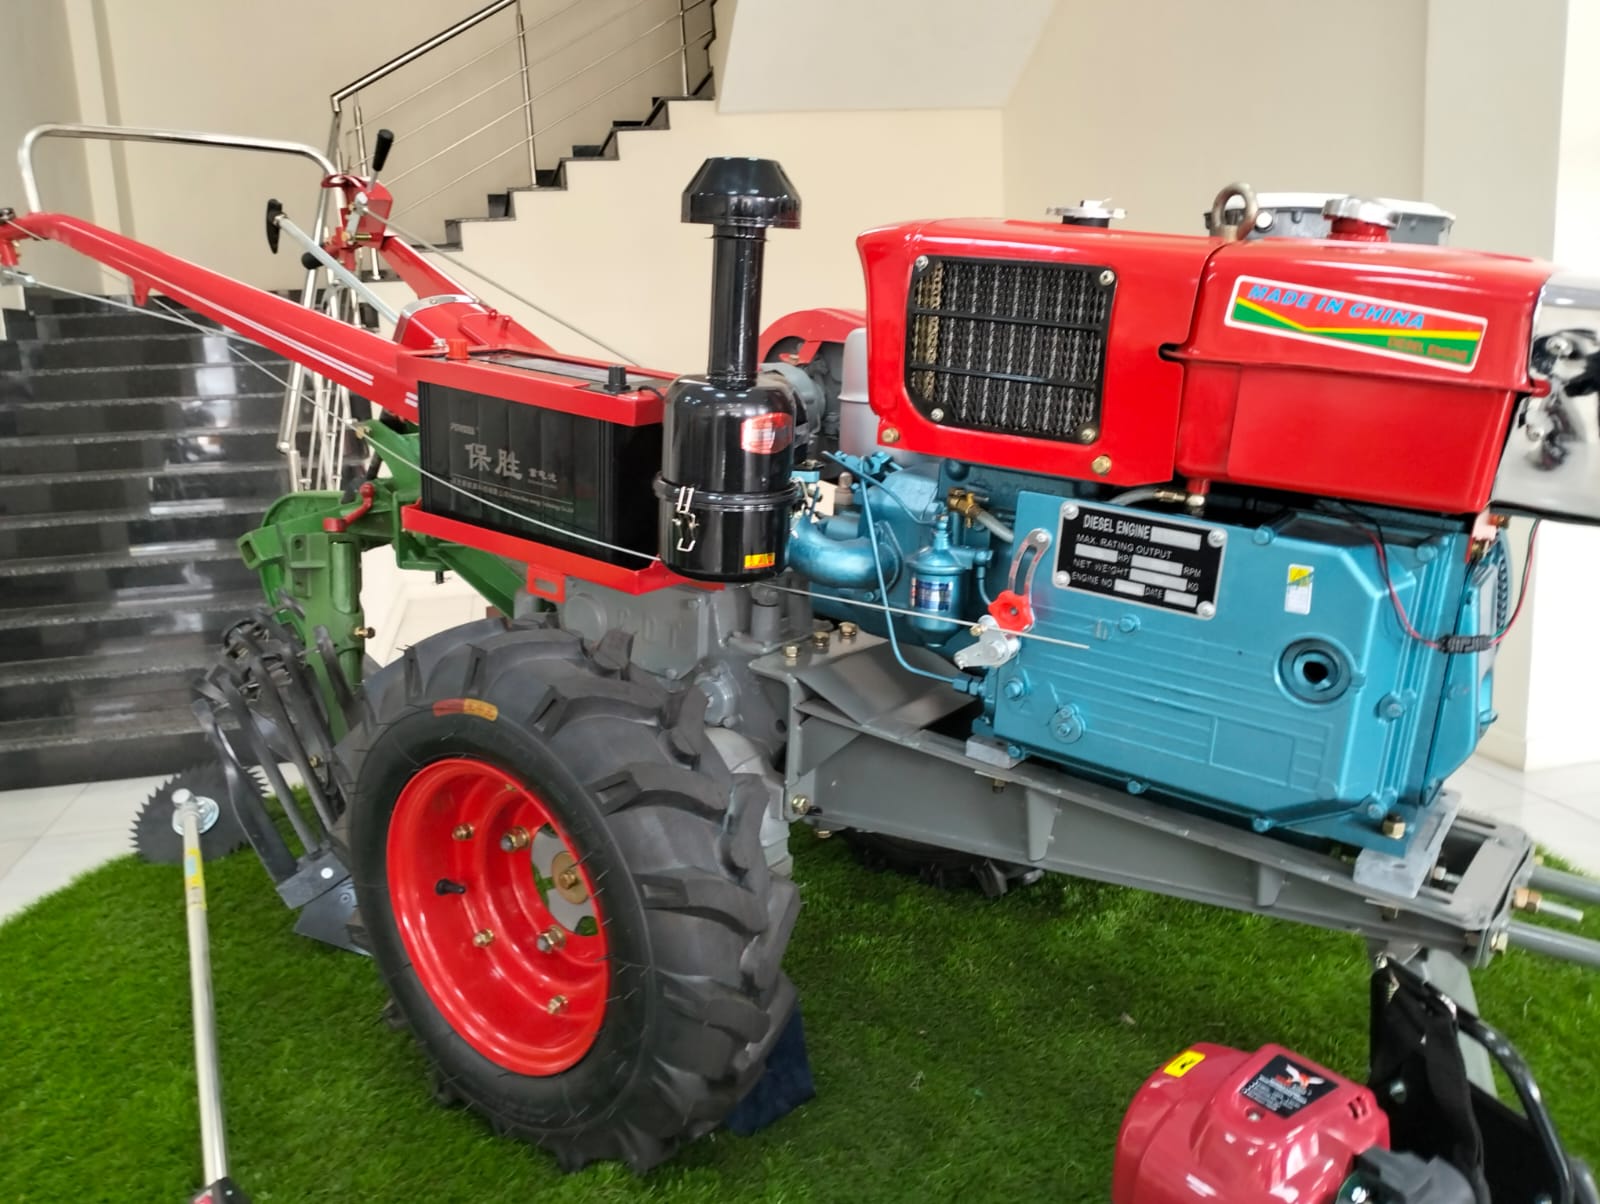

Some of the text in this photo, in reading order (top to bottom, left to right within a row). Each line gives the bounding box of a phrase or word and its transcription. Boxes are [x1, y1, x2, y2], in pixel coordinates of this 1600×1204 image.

[1248, 284, 1424, 330] MADE IN CHINA
[465, 442, 523, 480] 保胜
[1083, 514, 1151, 539] DIESEL ENGINE
[1076, 534, 1172, 559] MAX. RATING OUTPUT
[1071, 571, 1163, 599] ENGINE NO DATE
[1073, 558, 1199, 592] NET WEIGHT KG
[1183, 566, 1201, 577] RPM
